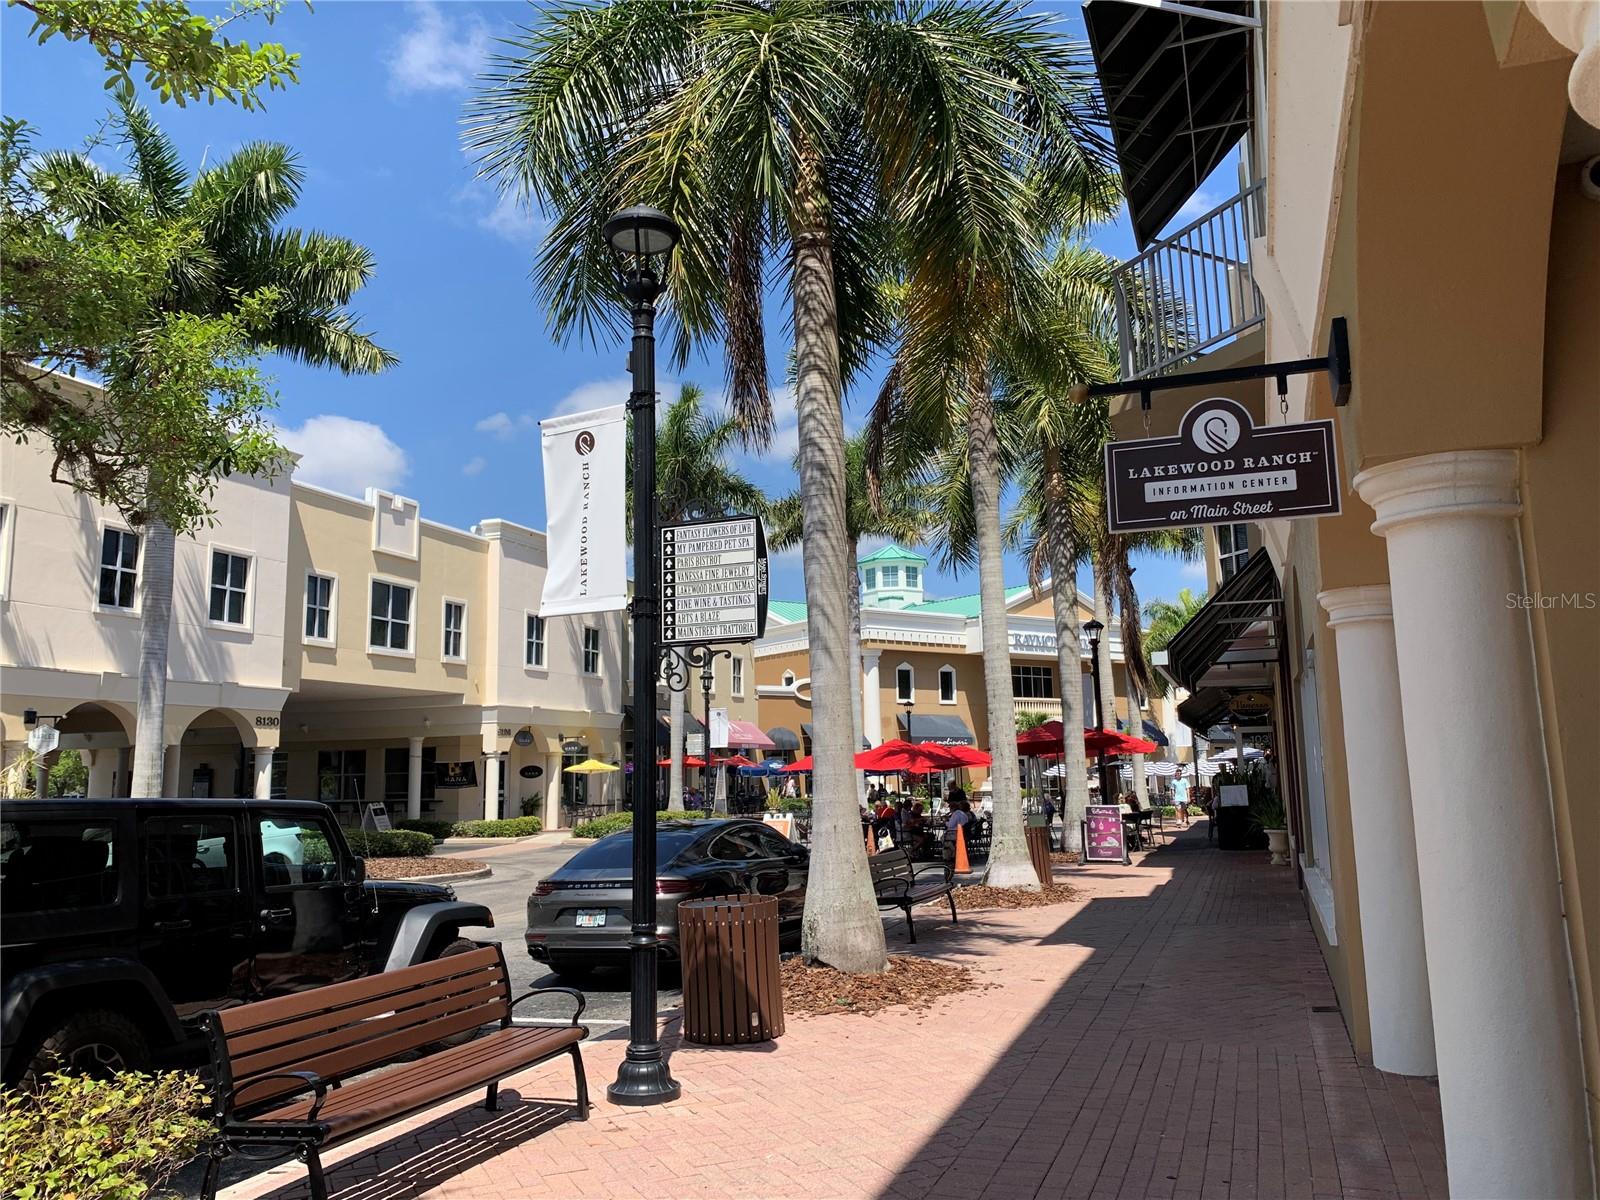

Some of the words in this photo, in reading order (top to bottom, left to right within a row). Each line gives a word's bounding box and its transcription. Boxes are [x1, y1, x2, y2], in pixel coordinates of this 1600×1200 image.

[1128, 458, 1236, 479] LAKEWOOD
[582, 462, 590, 511] RANCH
[1152, 480, 1235, 497] INFORMATION
[1242, 476, 1289, 489] CENTER
[1170, 508, 1189, 521] on
[1190, 503, 1230, 519] Main
[1232, 499, 1274, 515] Street
[676, 528, 701, 540] FANTASY
[702, 525, 729, 538] FLOWERS
[729, 525, 737, 534] OF
[738, 523, 752, 534] LWR
[677, 543, 686, 554] MY
[688, 540, 723, 553] PAMPERED
[724, 539, 737, 549] PET
[738, 537, 750, 548] SPA
[580, 516, 588, 597] LAKEWOOD
[677, 556, 694, 568] PARIS
[695, 554, 721, 567] BISTROT
[677, 570, 703, 582] VANESSA
[705, 568, 720, 580] FINE
[721, 566, 750, 578] JEWELRY
[676, 583, 708, 596] LAKEWOOD
[708, 581, 728, 593] RANCH
[728, 579, 755, 592] CINEMAS
[677, 599, 692, 610] FINE
[694, 597, 712, 608] WINE
[712, 597, 718, 607] &
[719, 594, 751, 606] TASTINGS
[677, 612, 694, 624] ARTS
[694, 612, 699, 623] A
[700, 611, 720, 622] BLAZE
[677, 626, 694, 638] MAIN
[695, 625, 718, 637] STREET
[719, 622, 754, 635] TRATTORIA
[255, 715, 280, 727] 8130
